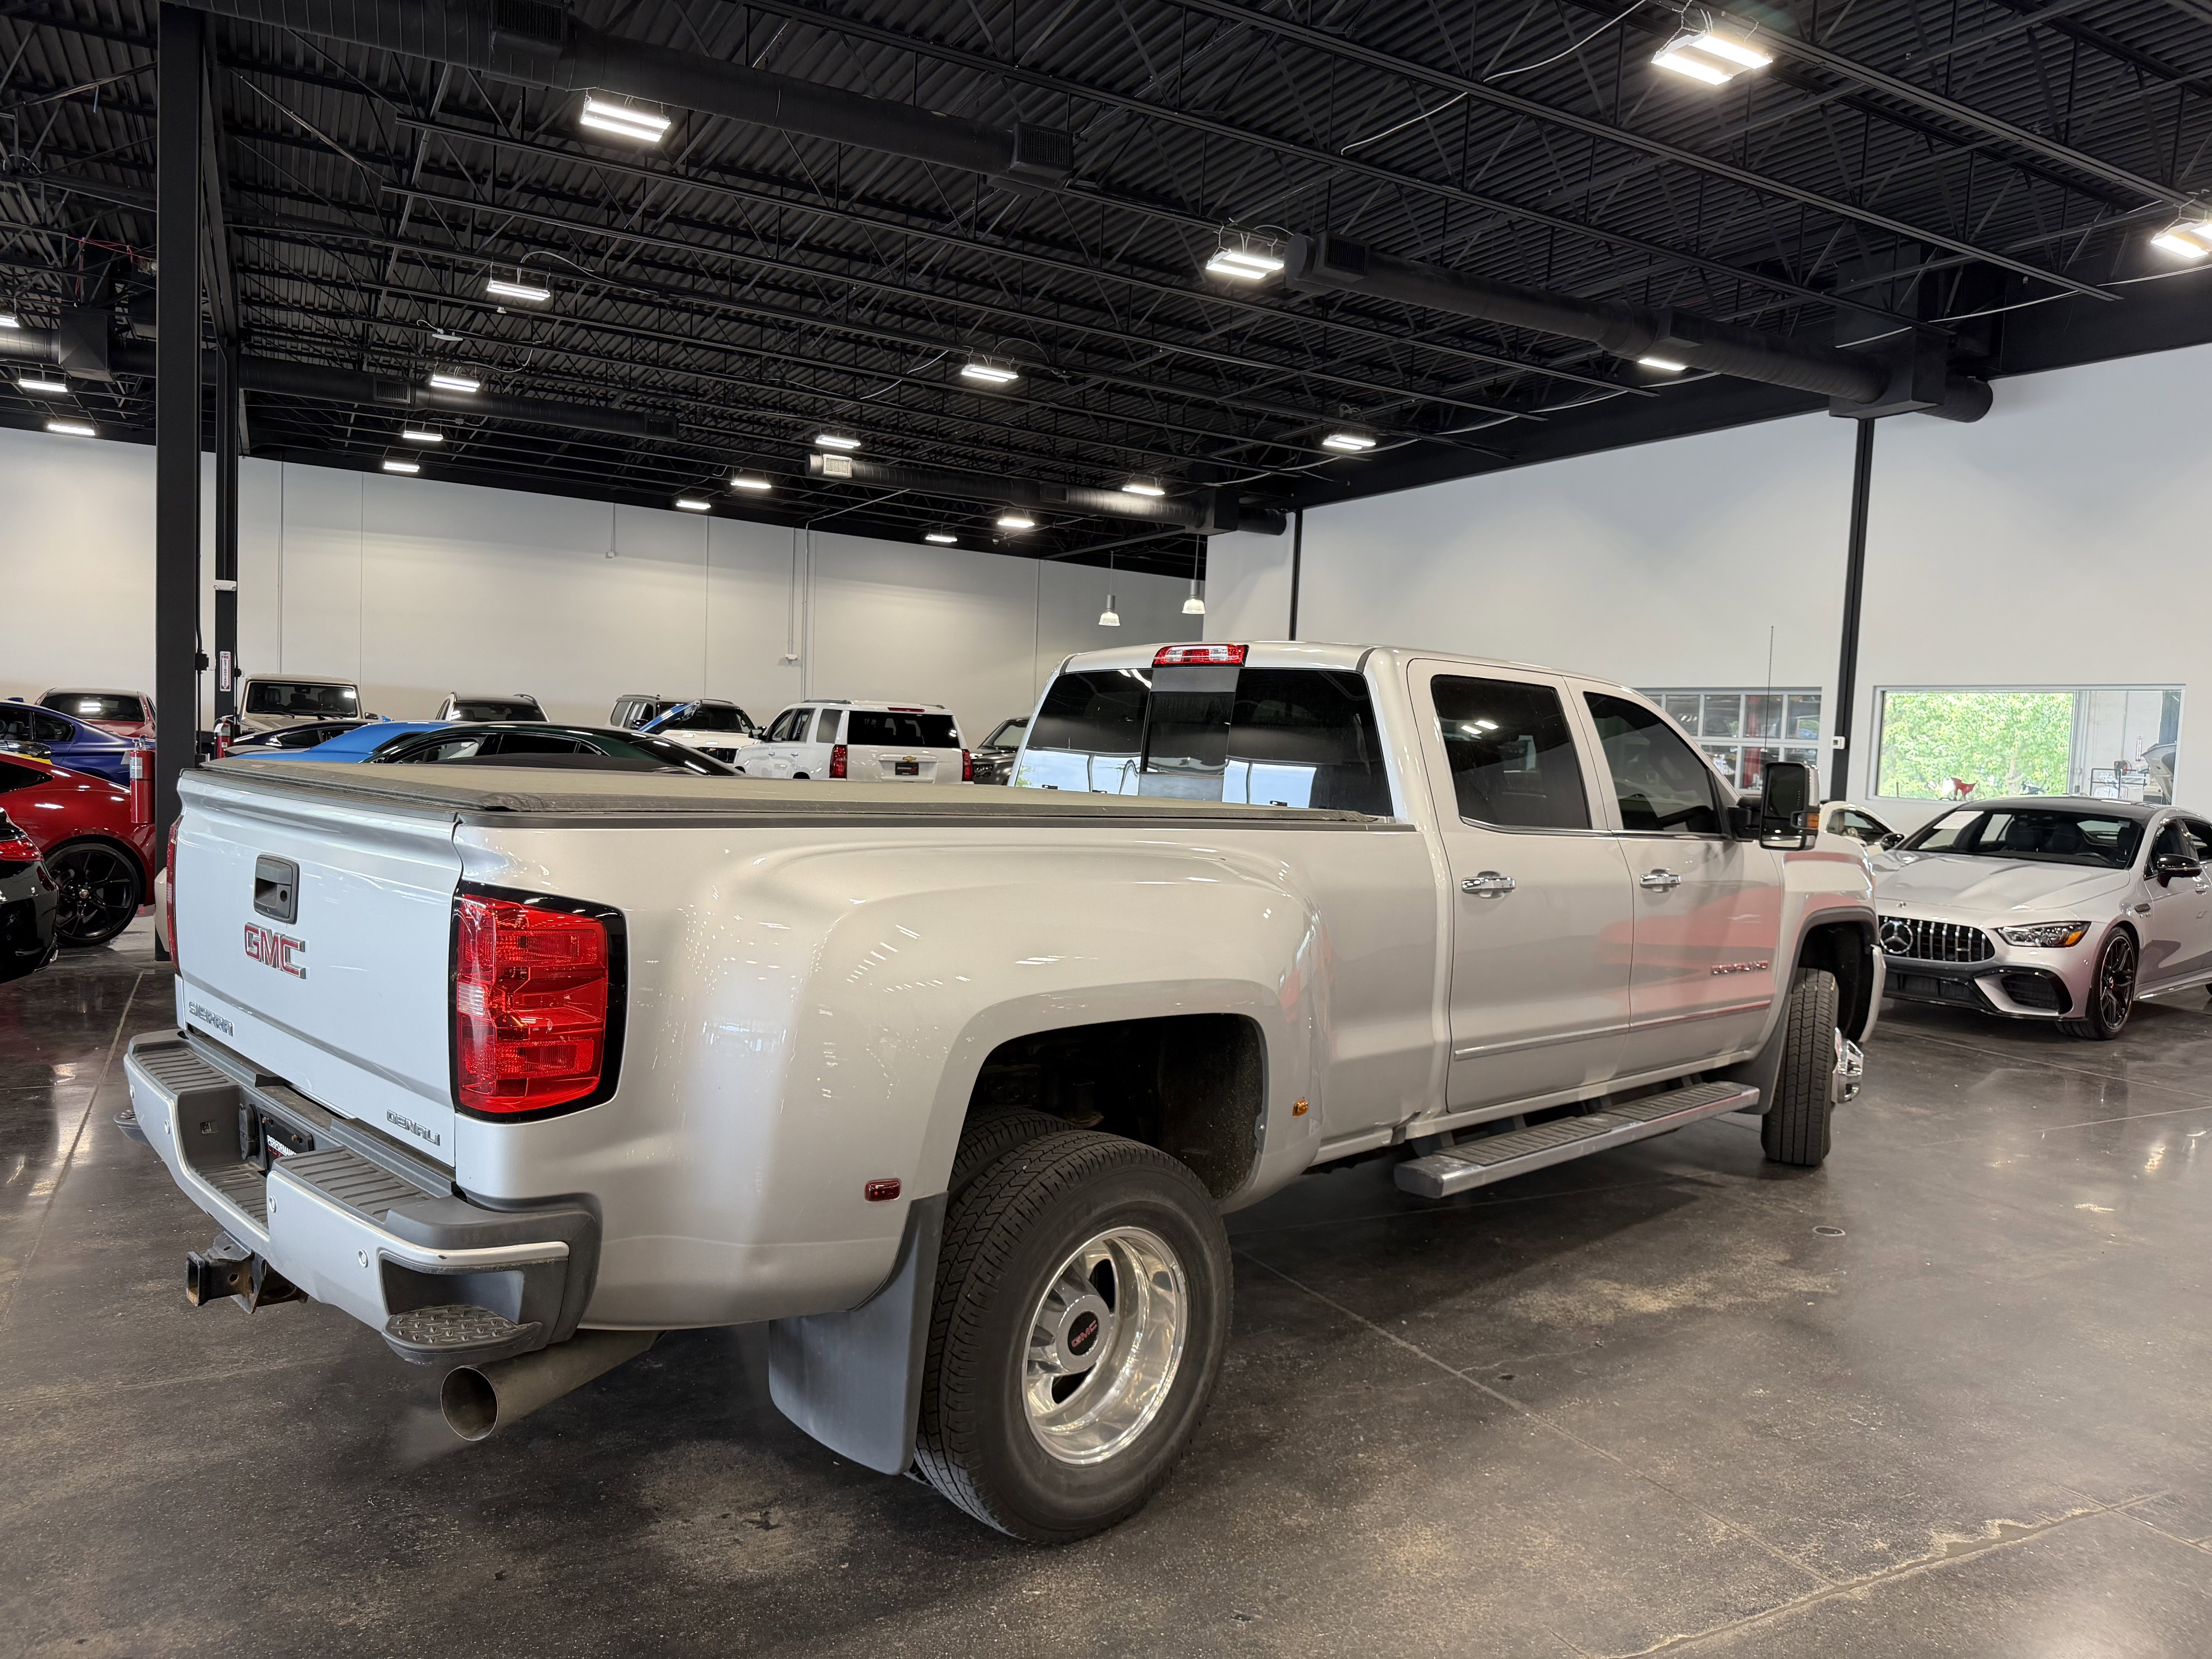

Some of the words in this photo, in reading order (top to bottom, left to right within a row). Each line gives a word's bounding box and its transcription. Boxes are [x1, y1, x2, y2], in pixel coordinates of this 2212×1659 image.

[244, 922, 307, 979] GMC
[189, 1001, 234, 1037] SIERRA
[386, 1109, 440, 1146] DENALI
[1072, 1320, 1097, 1347] GMC
